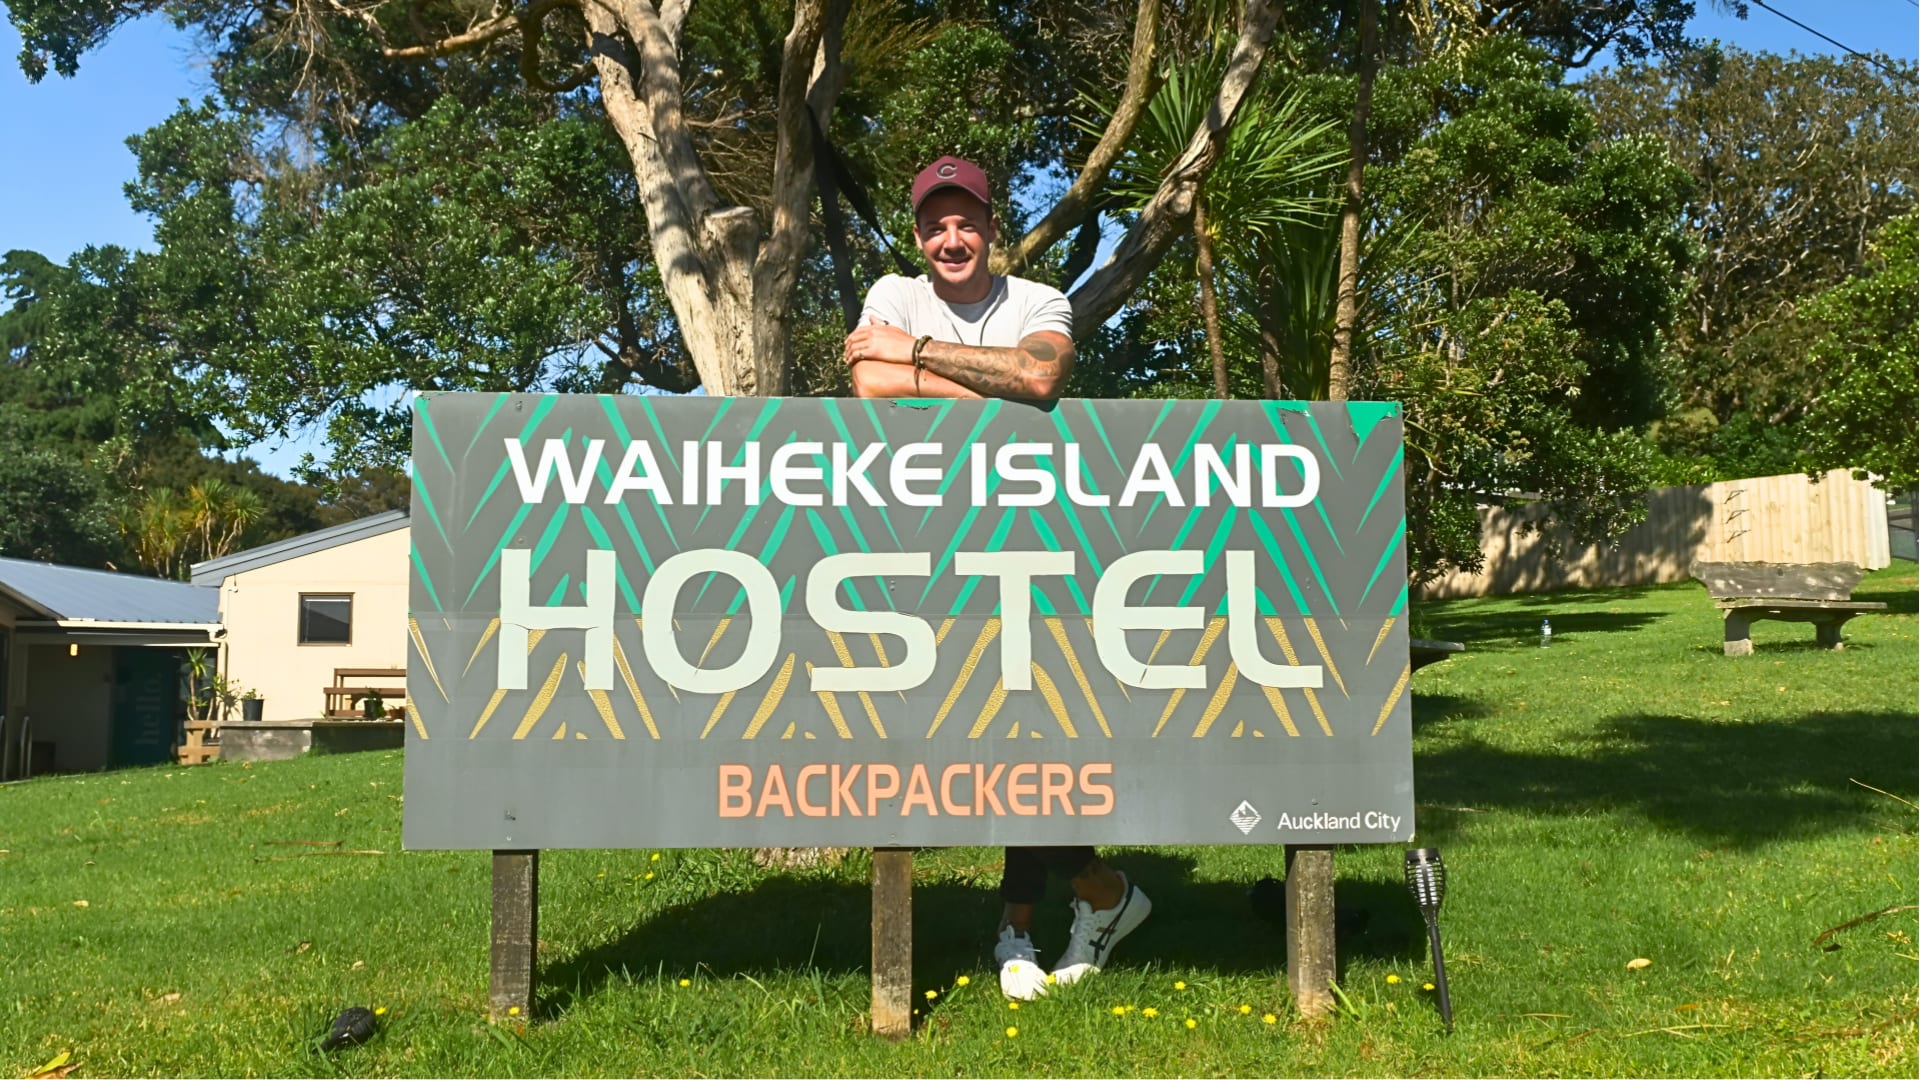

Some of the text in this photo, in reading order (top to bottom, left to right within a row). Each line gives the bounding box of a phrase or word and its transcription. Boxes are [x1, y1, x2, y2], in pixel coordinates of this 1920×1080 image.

[936, 163, 958, 179] C
[504, 438, 1321, 508] WAIHEKE ISLAND
[497, 548, 1324, 694] HOSTEL
[718, 762, 1116, 819] BACKPACKERS
[1277, 811, 1401, 832] Auckland City
